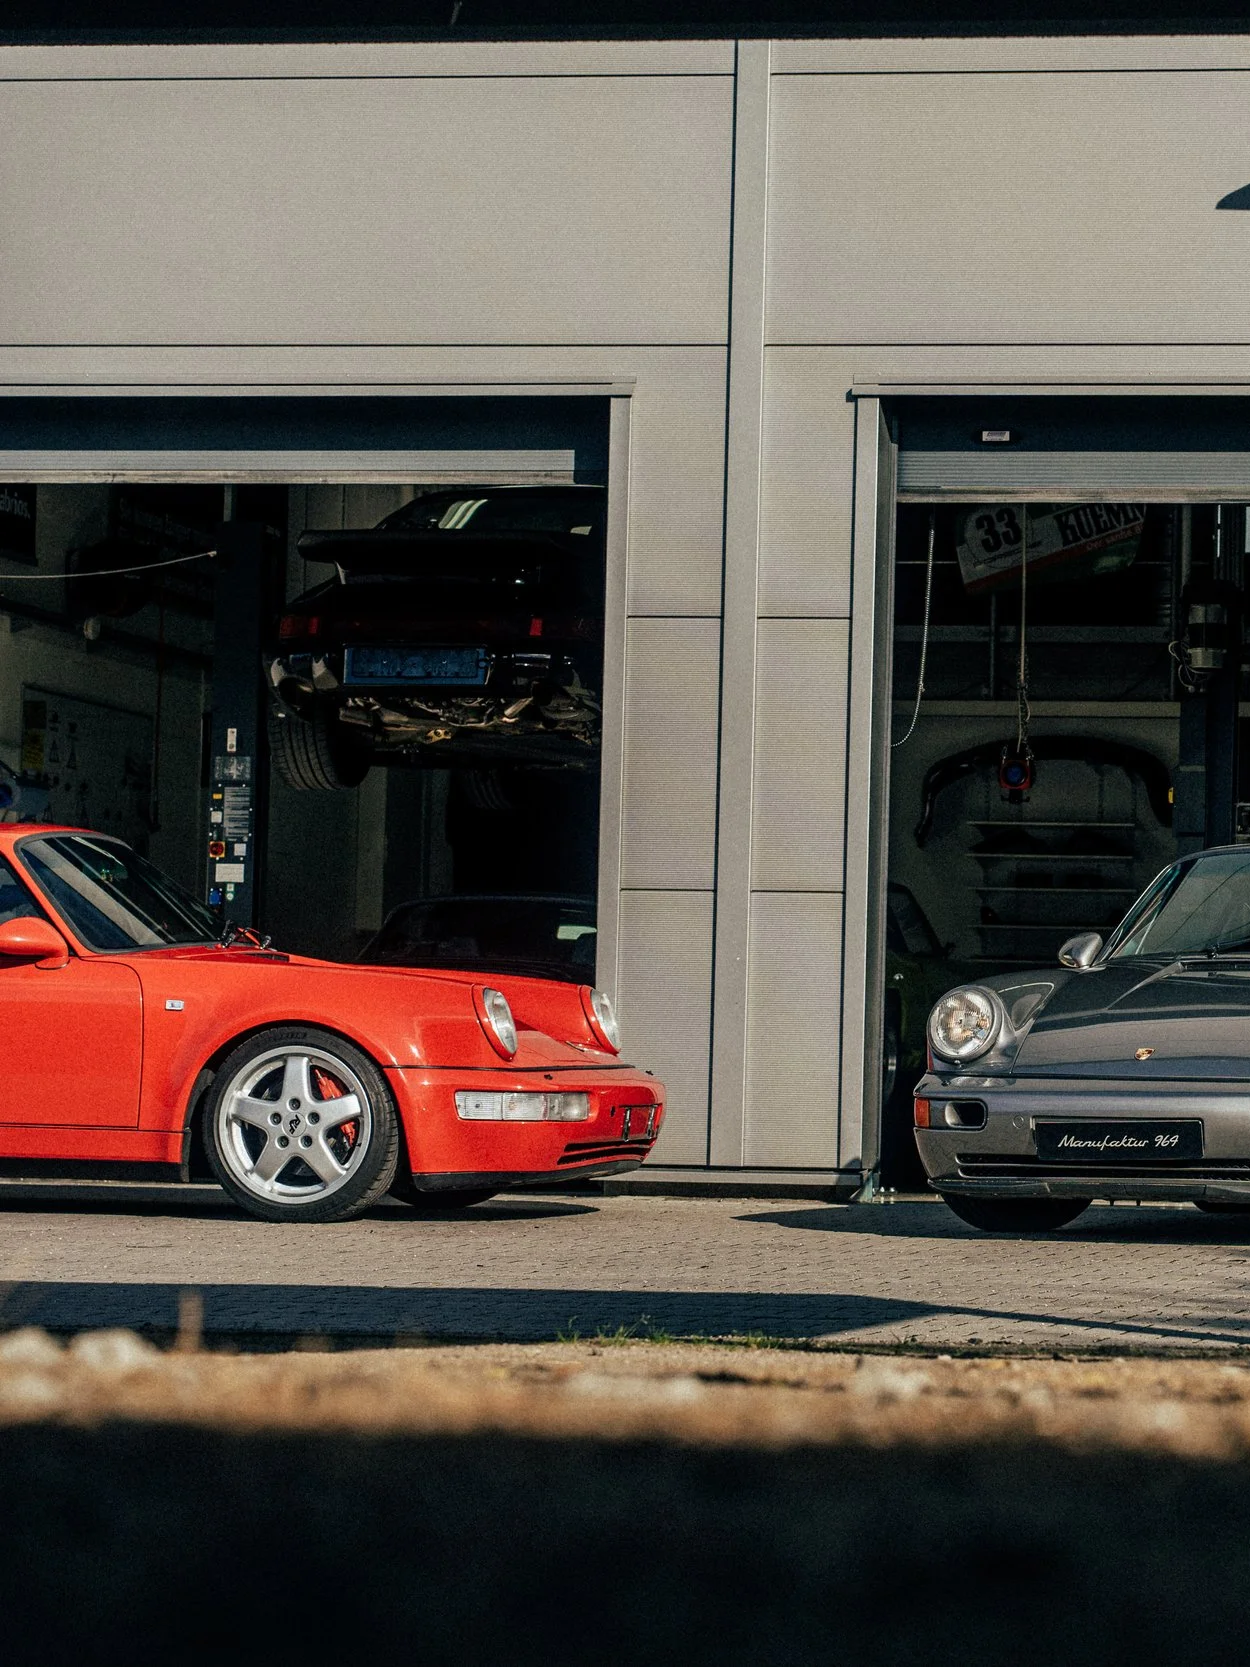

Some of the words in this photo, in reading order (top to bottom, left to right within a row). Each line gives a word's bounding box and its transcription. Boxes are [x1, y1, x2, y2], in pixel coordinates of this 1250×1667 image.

[976, 507, 1022, 553] 33
[1057, 1134, 1149, 1151] Manufaktur
[1154, 1134, 1179, 1148] 964
